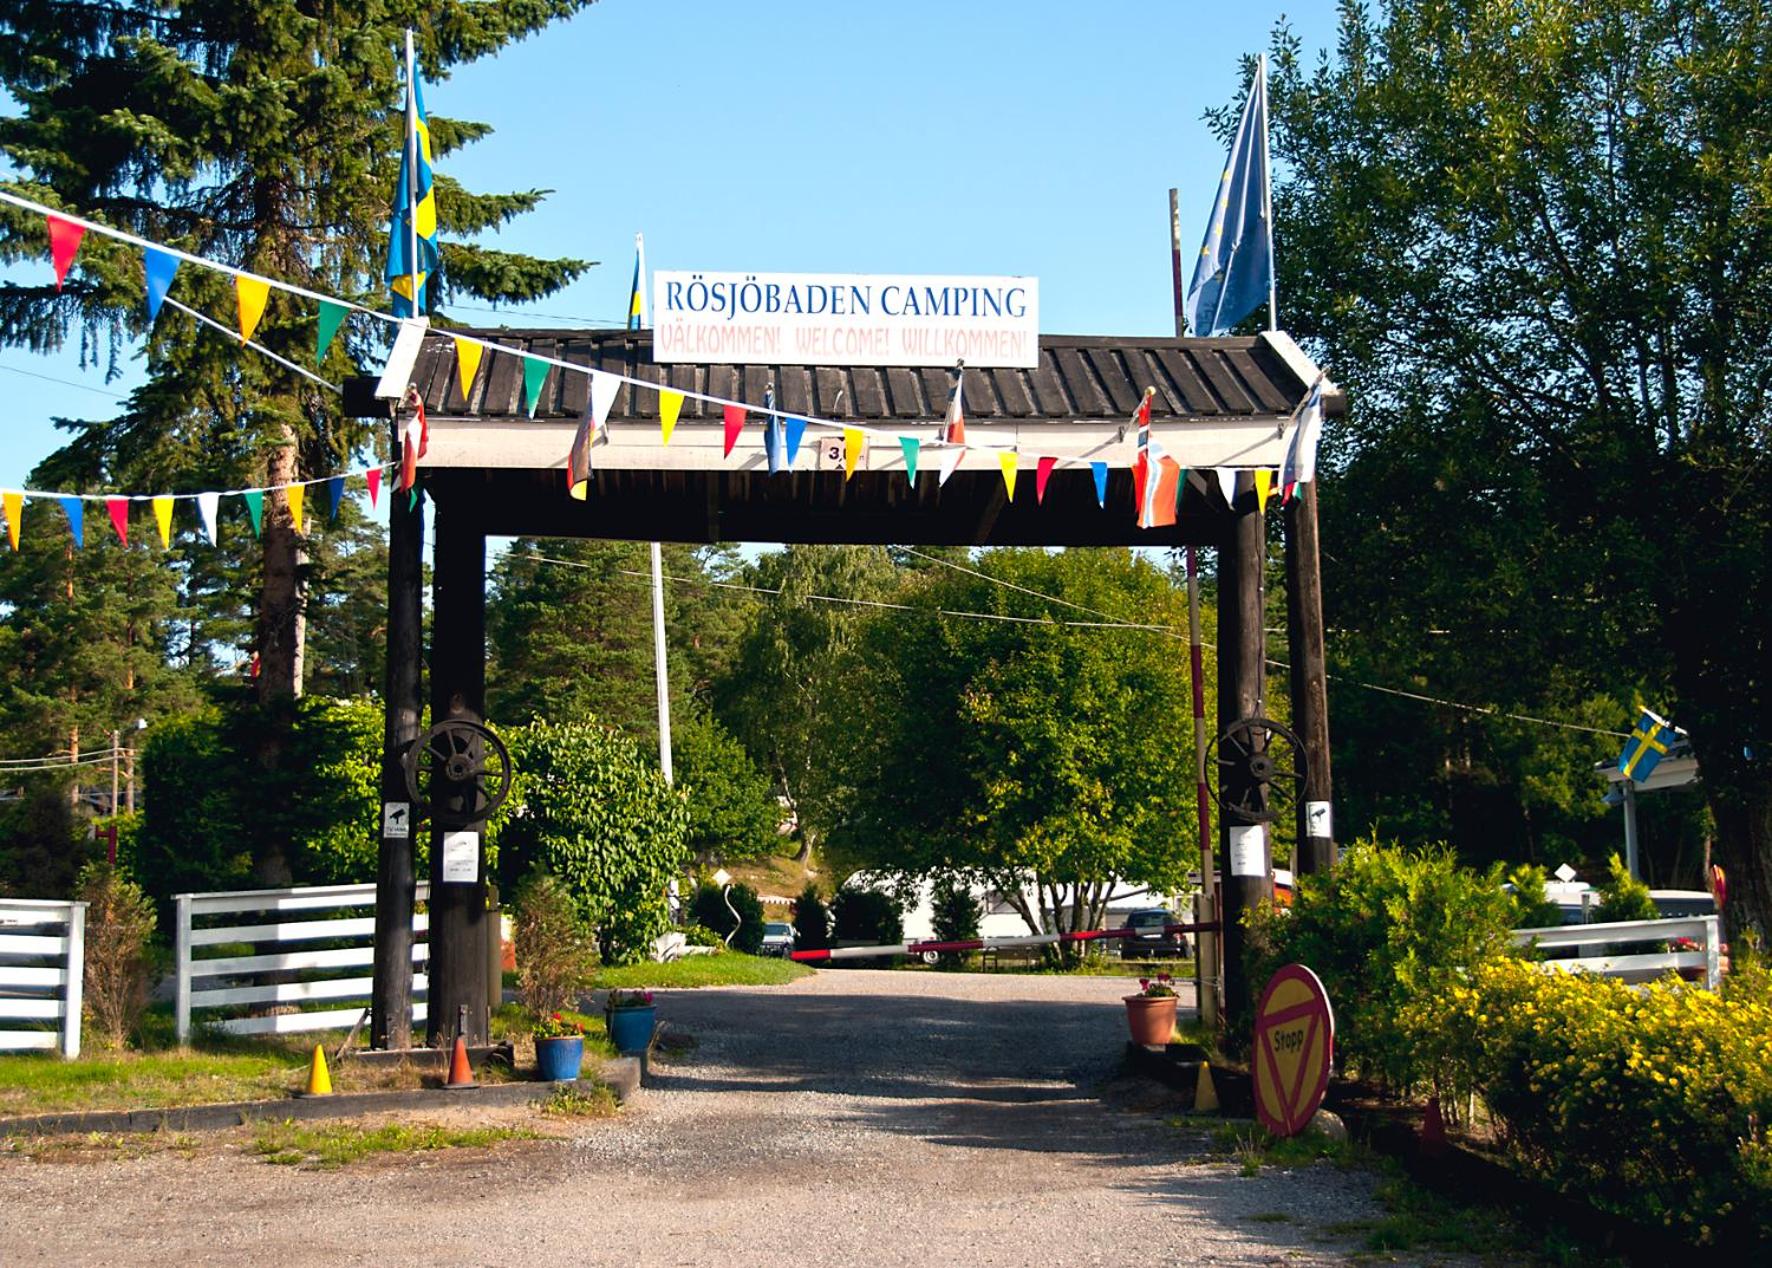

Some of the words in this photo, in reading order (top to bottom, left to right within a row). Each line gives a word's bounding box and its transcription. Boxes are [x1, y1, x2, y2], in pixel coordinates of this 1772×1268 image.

[666, 275, 871, 320] RÖSJÖBADEN
[880, 285, 1026, 318] CAMPING
[661, 317, 781, 356] VÄLKOMMEN!
[795, 326, 889, 357] WELCOME!
[902, 327, 1027, 359] WILLKOMMEN!
[1273, 1029, 1304, 1054] Stopp
